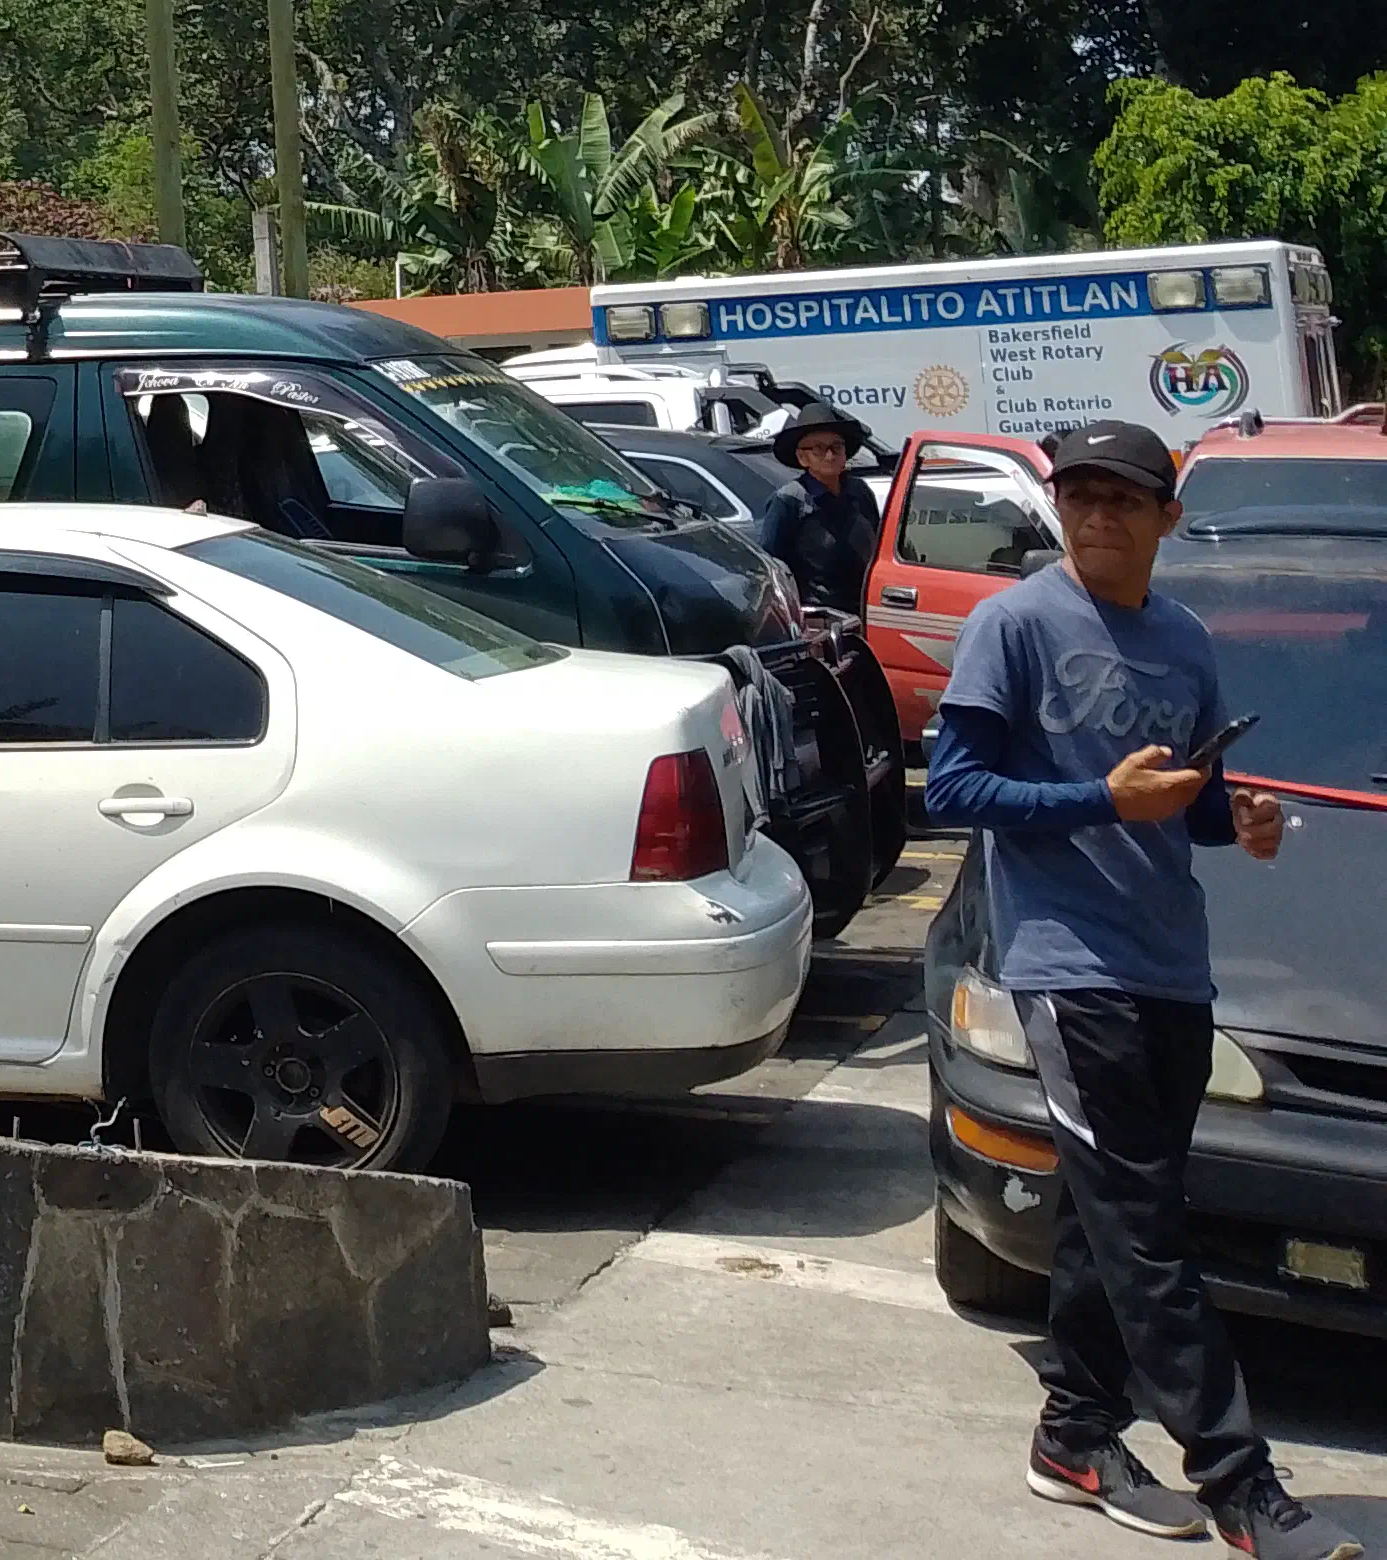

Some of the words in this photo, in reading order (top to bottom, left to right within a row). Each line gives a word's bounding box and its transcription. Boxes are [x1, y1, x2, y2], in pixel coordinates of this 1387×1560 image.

[719, 291, 965, 333] HOSPITALITO
[976, 280, 1138, 318] ATITLAN
[988, 323, 1092, 343] Bakersfield
[990, 346, 1037, 363] West
[1042, 344, 1104, 361] Rotary
[992, 366, 1033, 381] Club
[818, 385, 907, 407] Rotary
[996, 385, 1005, 395] &
[996, 398, 1037, 413] Club
[1043, 394, 1112, 412] Rotario
[999, 416, 1097, 433] Guatemal
